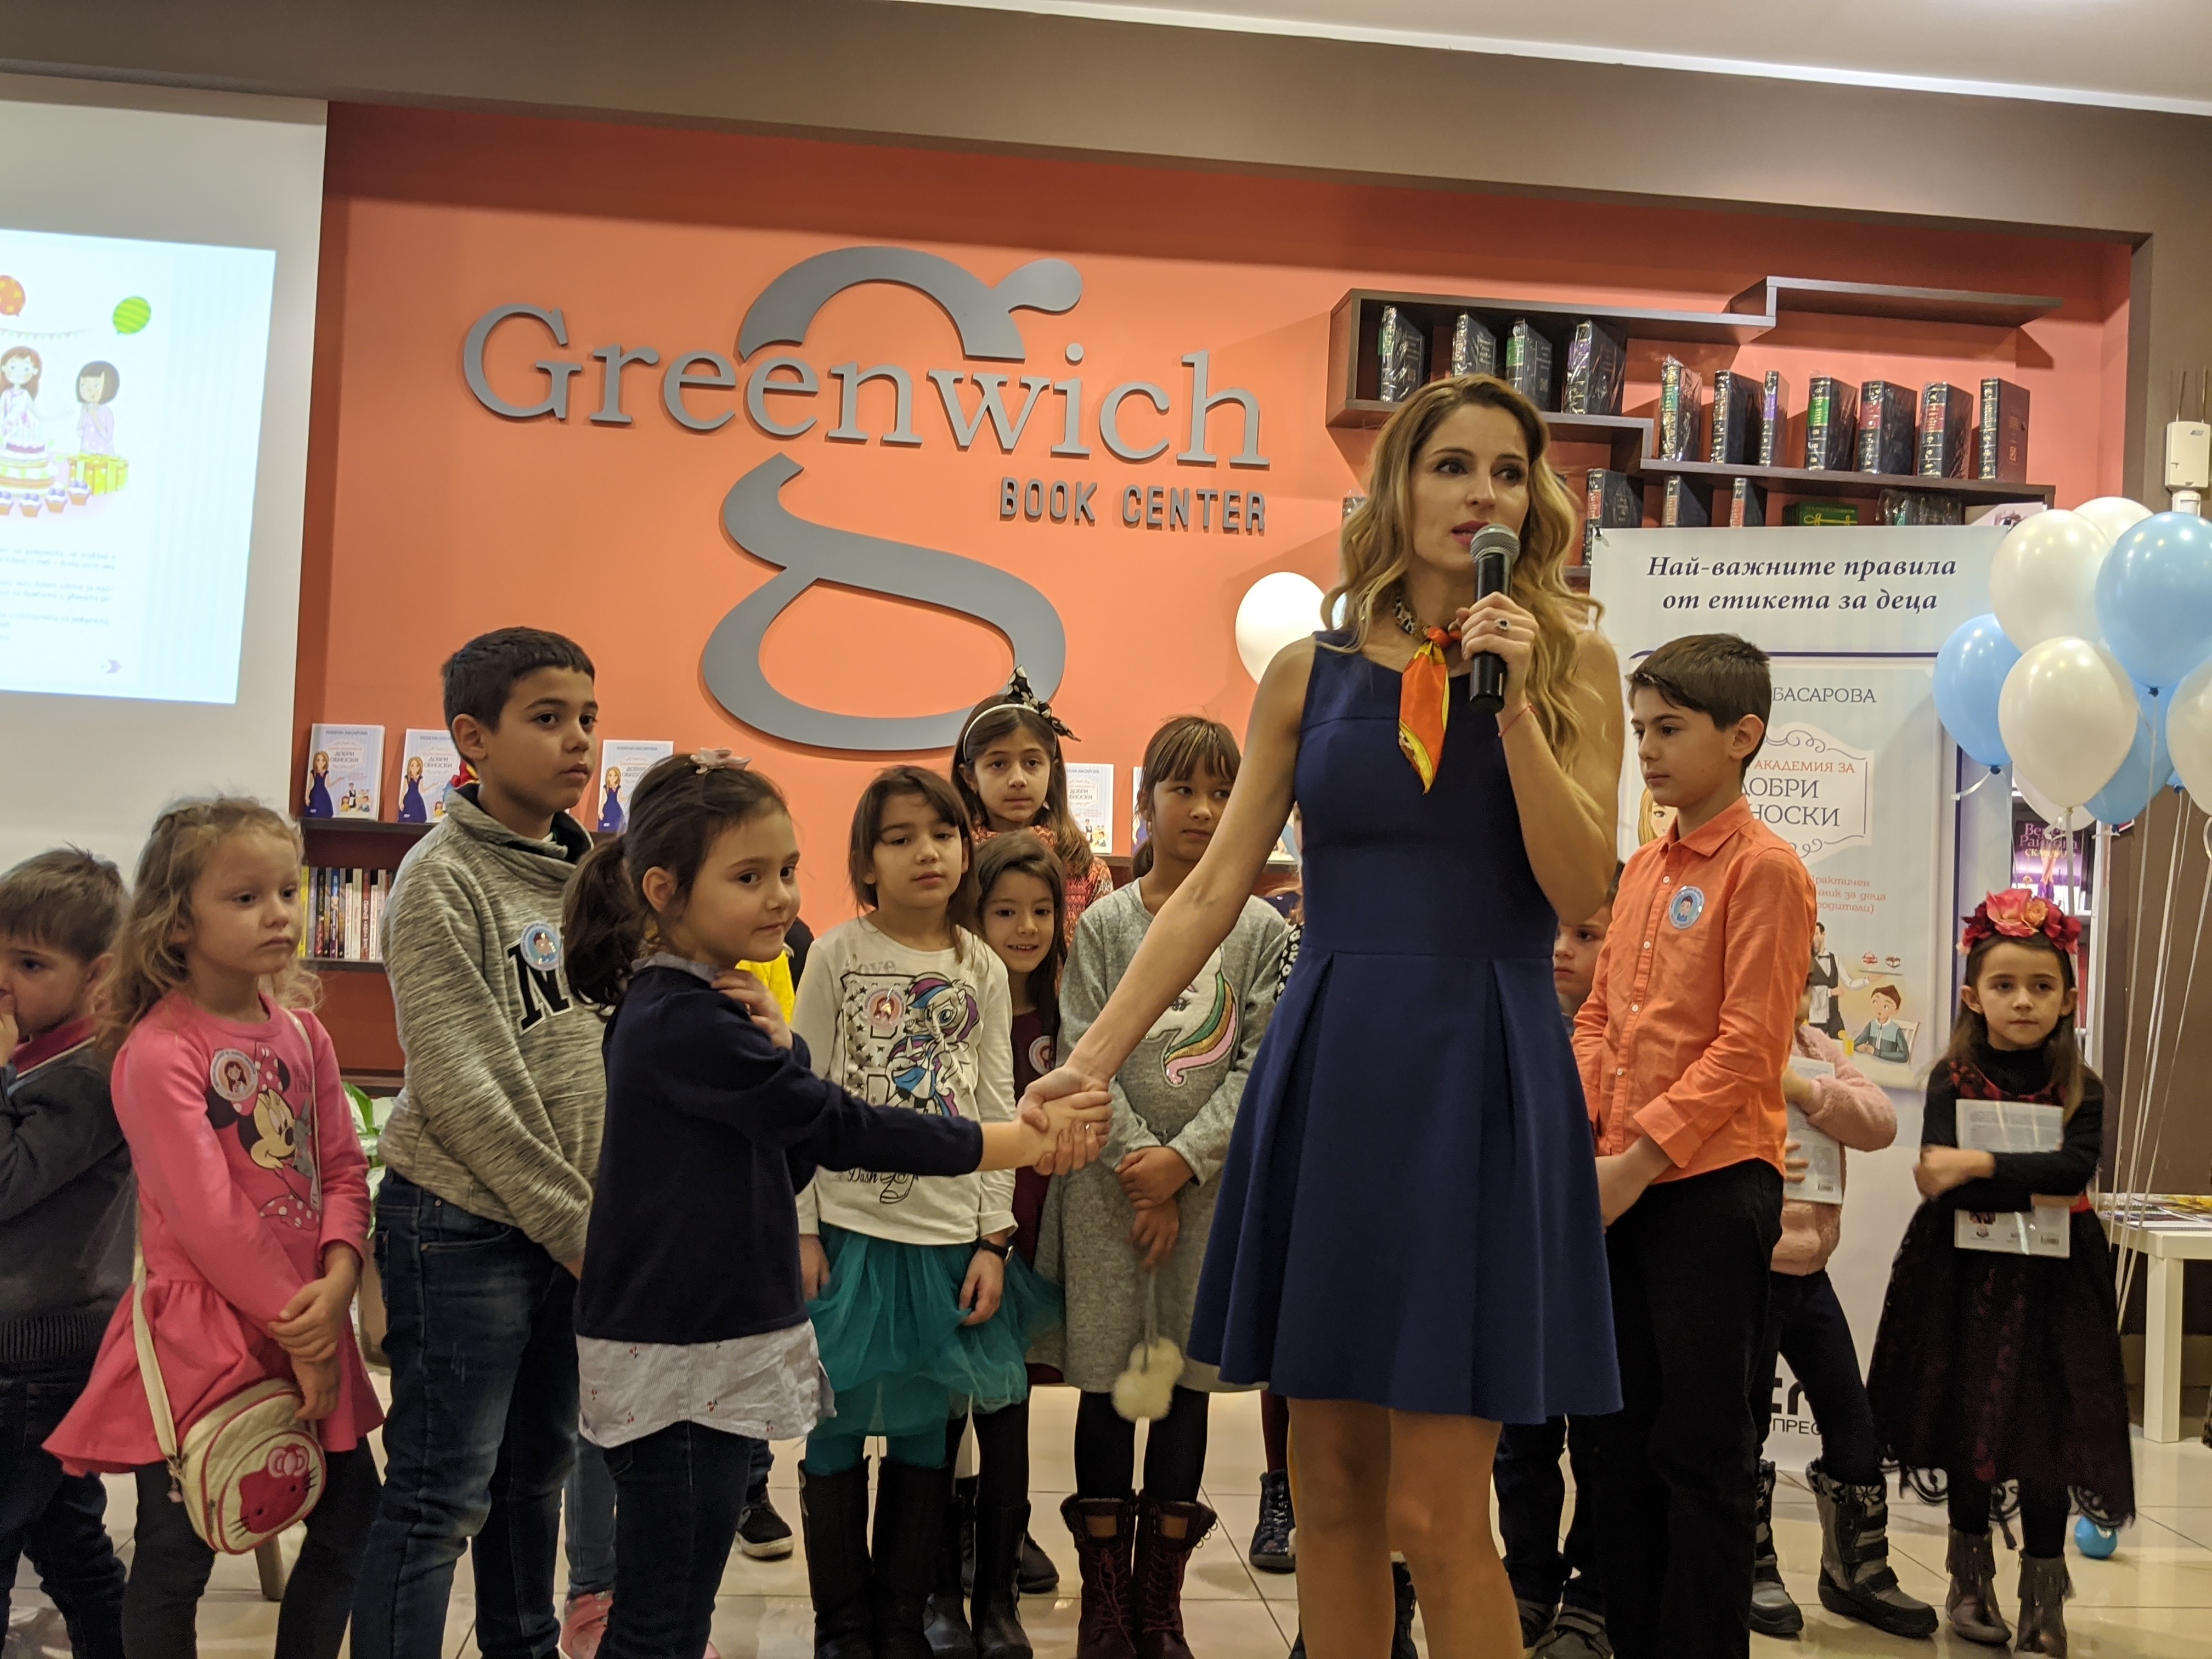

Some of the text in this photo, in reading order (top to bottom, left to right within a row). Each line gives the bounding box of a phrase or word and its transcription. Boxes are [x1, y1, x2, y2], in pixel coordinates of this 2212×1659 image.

[464, 303, 1270, 469] Greenwich
[1001, 476, 1265, 533] BOOK CENTER
[1646, 556, 1956, 582] Най-важните правила
[1662, 588, 1937, 614] от етикета за деца
[1771, 687, 1877, 703] БАСАРОВА
[1754, 759, 1855, 773] АКАДЕМИЯ ЗА
[1749, 804, 1840, 827] НОСКИ
